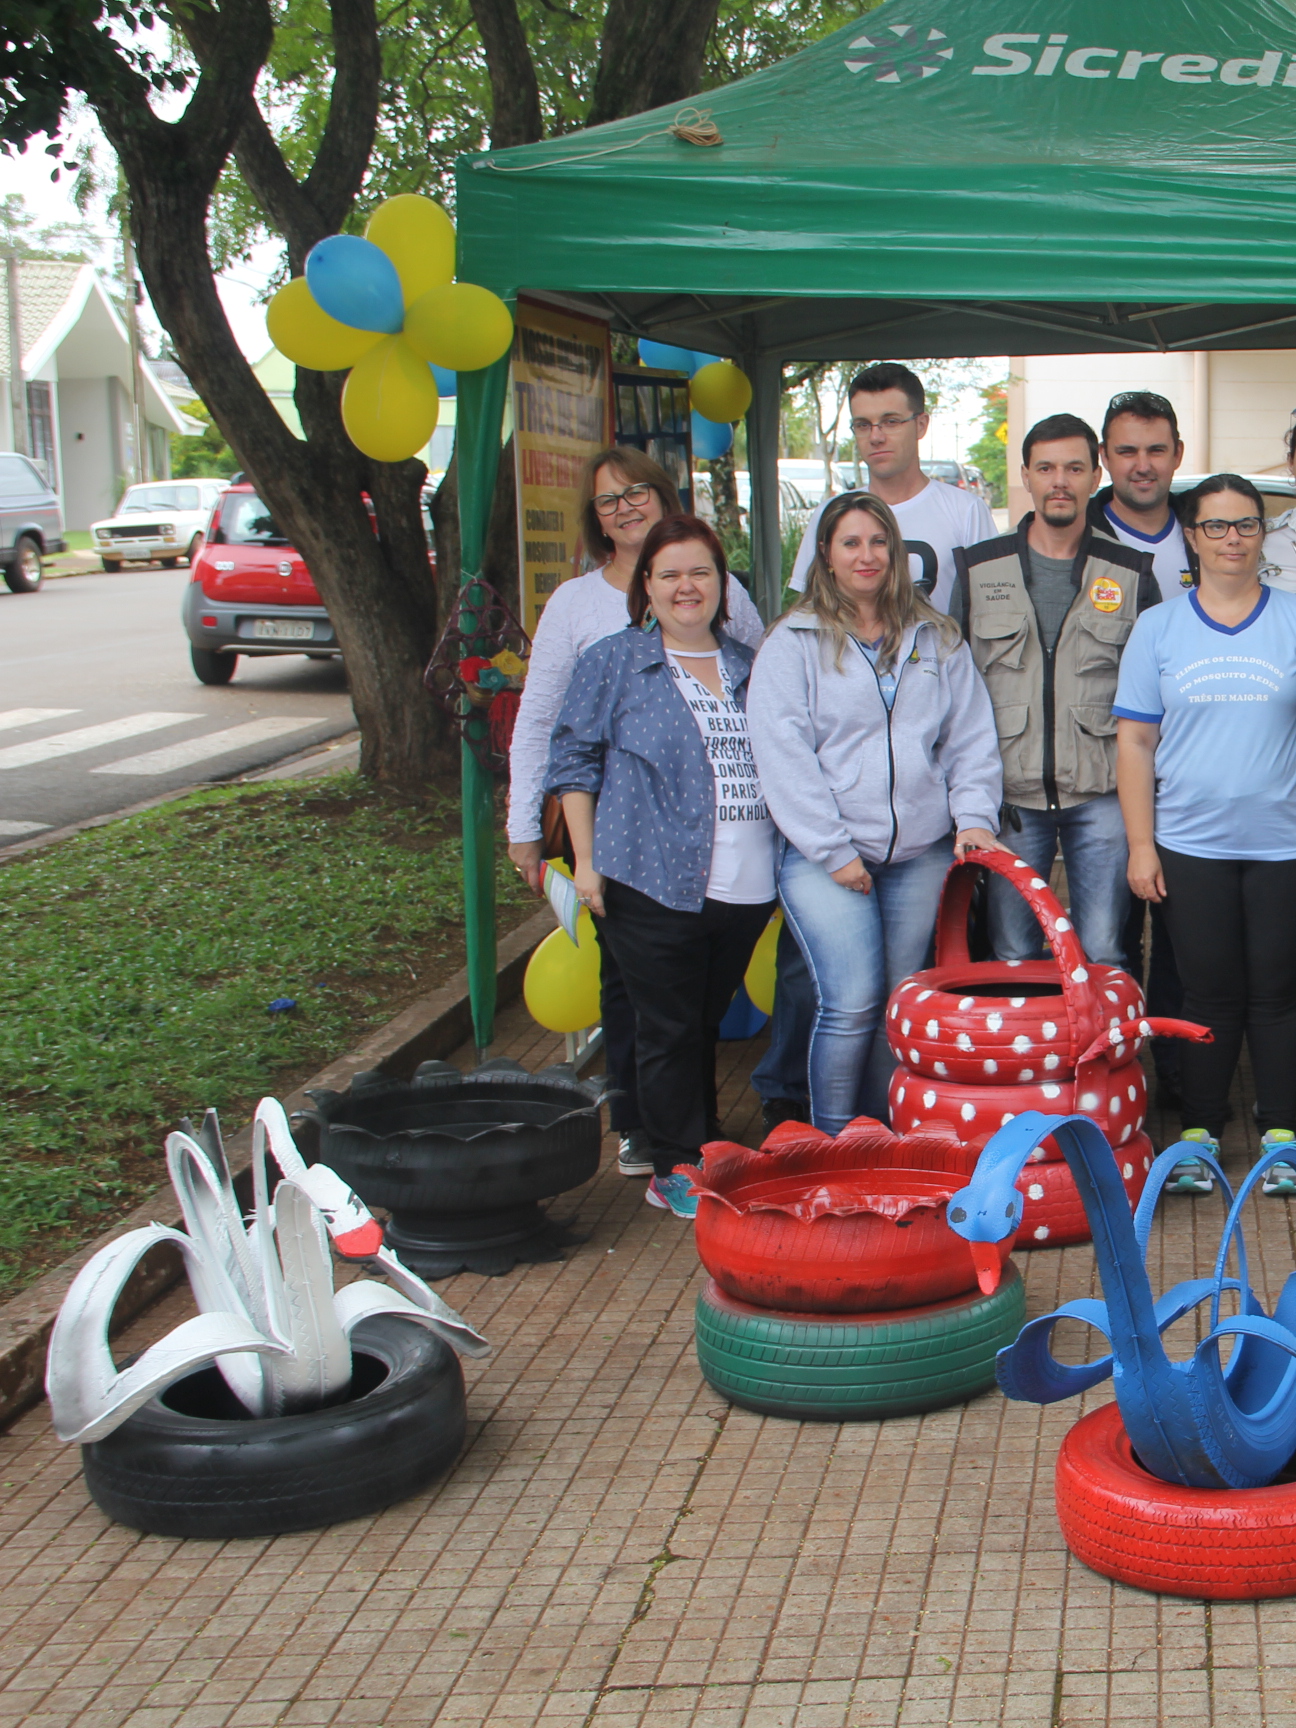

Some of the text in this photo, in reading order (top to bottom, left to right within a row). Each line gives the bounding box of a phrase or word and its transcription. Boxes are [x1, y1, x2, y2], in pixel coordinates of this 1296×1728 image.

[1175, 657, 1211, 681] ELIMINE
[1226, 655, 1285, 679] CRIADOUROS
[1179, 672, 1280, 694] DO MOSQUITO AEDES
[689, 699, 719, 713] NEW
[1188, 693, 1212, 703] TRÊS
[1214, 694, 1227, 702] DE
[722, 783, 758, 799] PARIS
